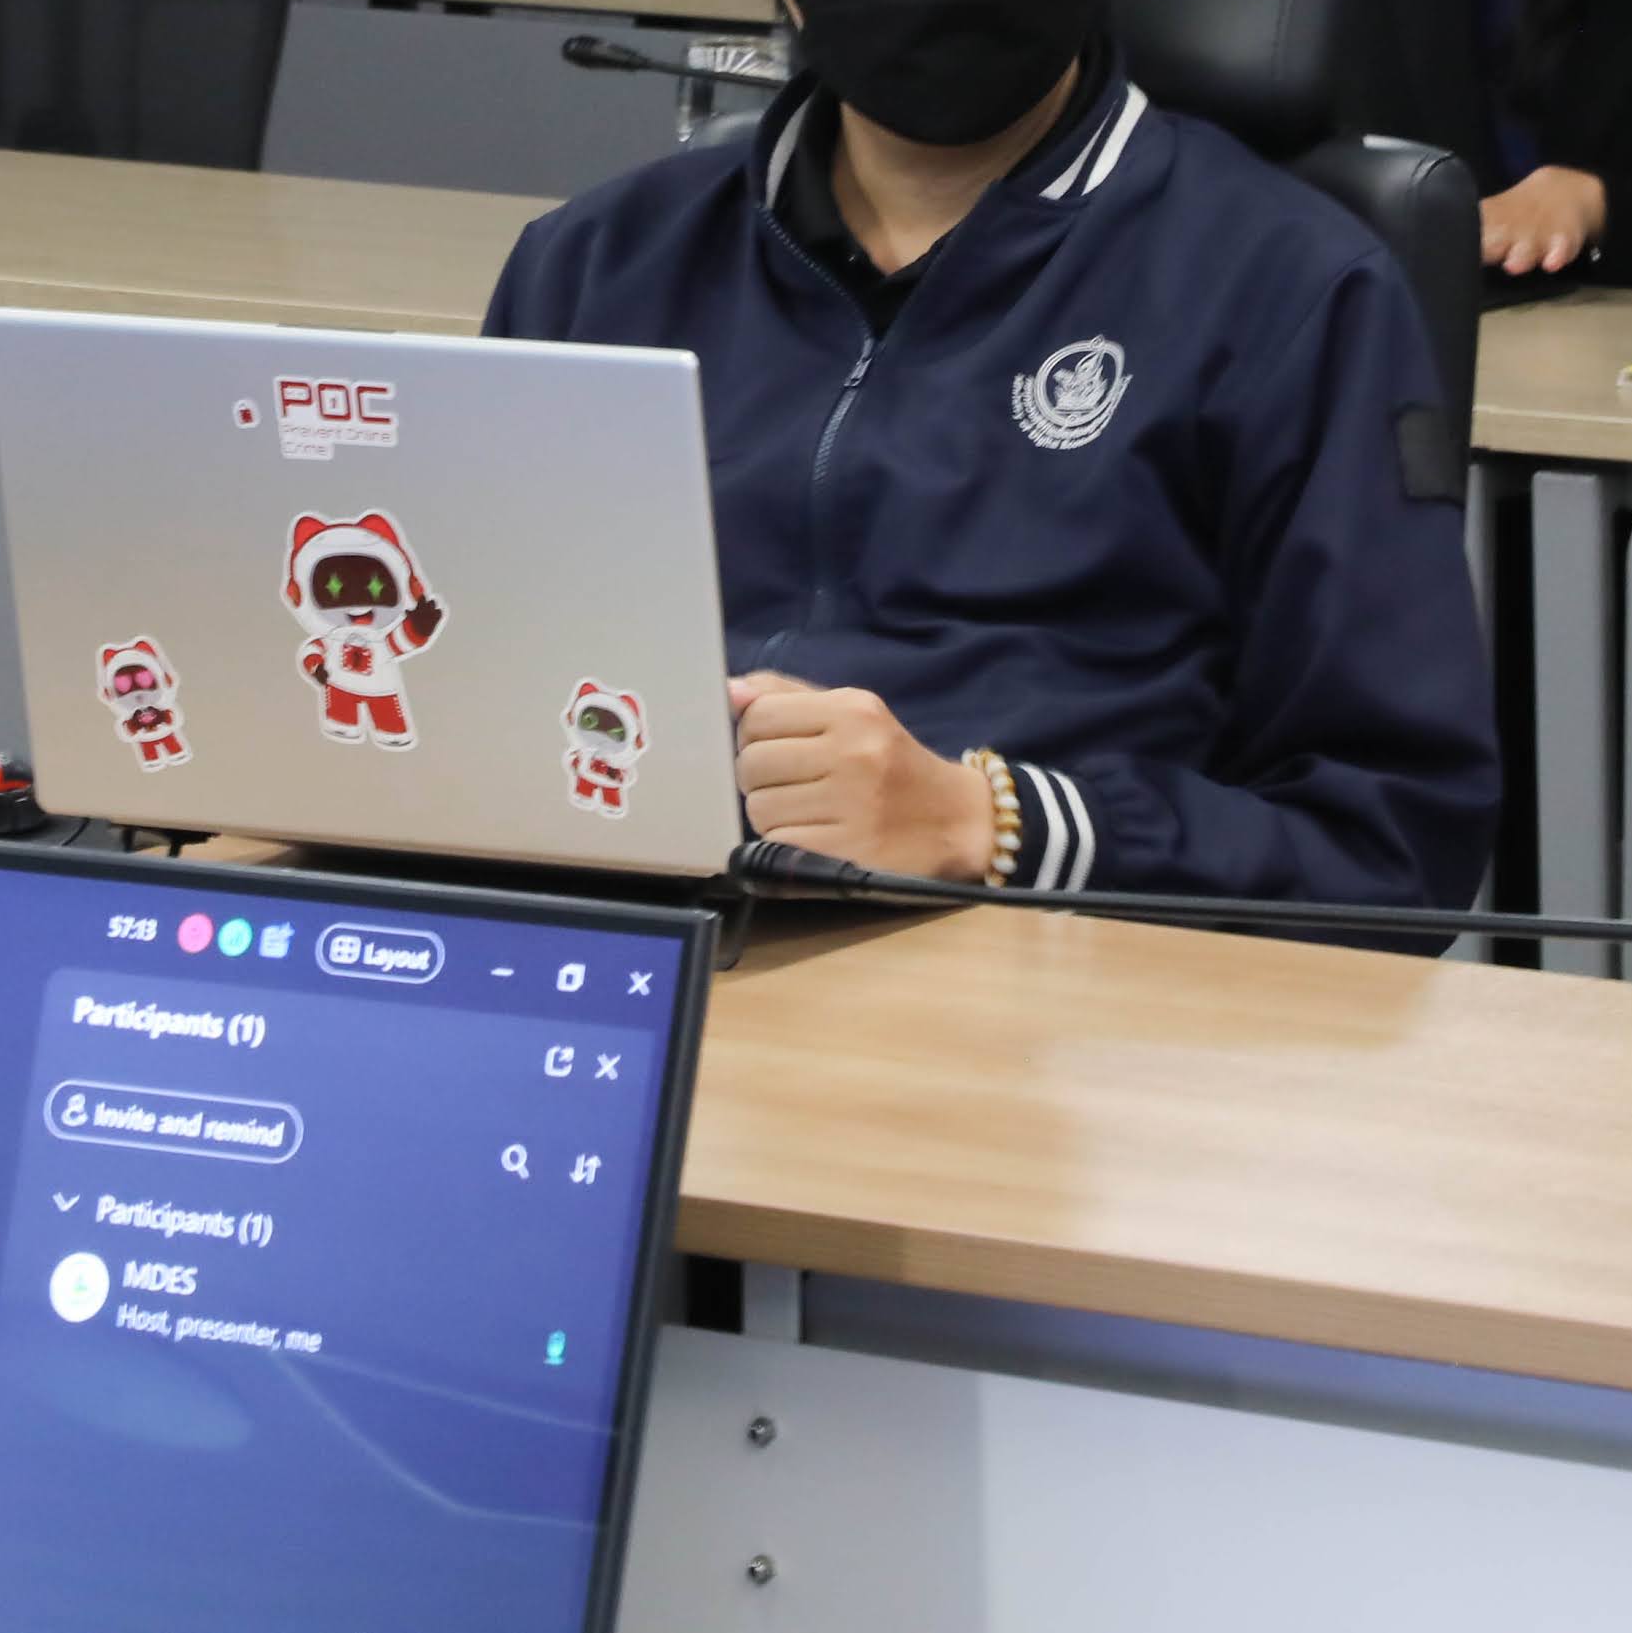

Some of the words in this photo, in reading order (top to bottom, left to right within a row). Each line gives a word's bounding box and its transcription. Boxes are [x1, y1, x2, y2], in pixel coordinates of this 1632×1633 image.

[279, 380, 392, 424] POC
[363, 943, 432, 972] Layout
[71, 995, 225, 1039] Participants
[226, 1013, 266, 1048] (1)
[93, 1102, 157, 1133] Invite
[157, 1112, 204, 1138] and
[204, 1119, 286, 1148] remind
[96, 1193, 235, 1238] Participants
[237, 1212, 274, 1249] (1)
[122, 1260, 198, 1296] MDES
[116, 1302, 173, 1337] Host,
[173, 1316, 281, 1352] presenter,
[283, 1329, 323, 1354] me
